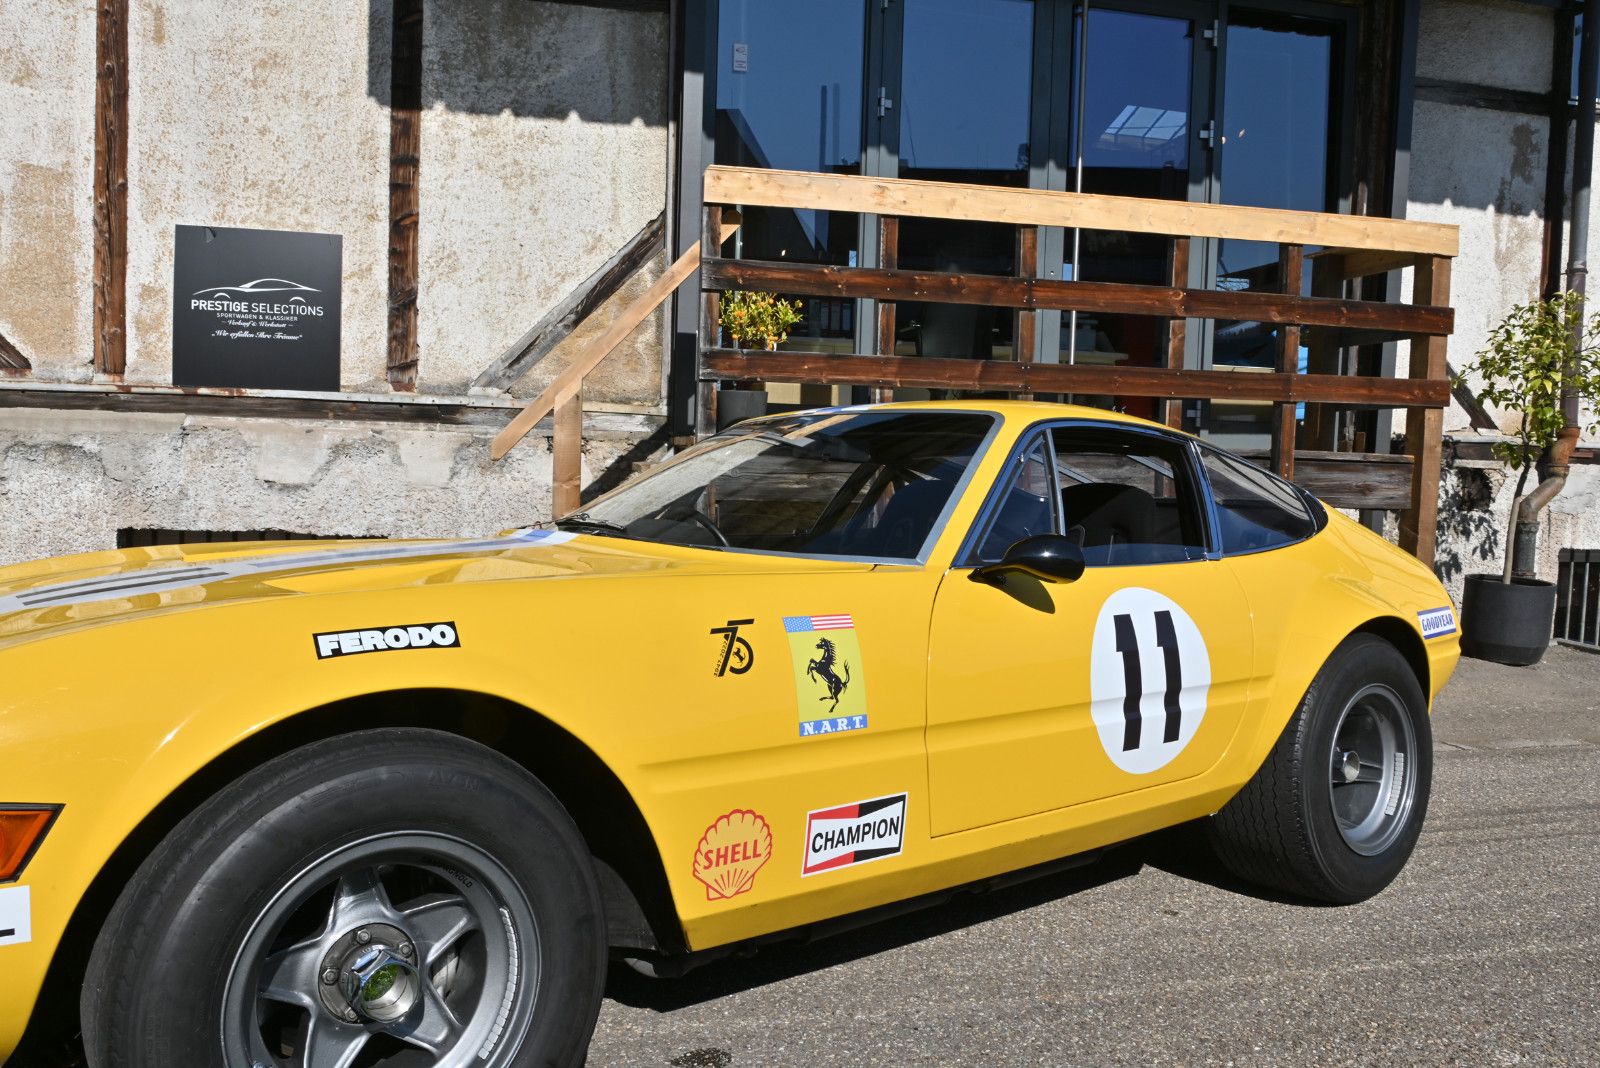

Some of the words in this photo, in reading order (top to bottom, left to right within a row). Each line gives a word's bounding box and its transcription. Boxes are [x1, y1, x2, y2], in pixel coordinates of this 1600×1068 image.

[191, 299, 249, 313] PRESTIGE
[251, 302, 324, 316] SELECTIONS
[216, 312, 257, 320] SPORTWAGEN
[255, 331, 272, 339] Ihre
[1421, 613, 1454, 631] GOODYEAR
[316, 624, 456, 657] FERODO
[710, 618, 754, 677] 75
[1113, 610, 1182, 752] 11
[803, 715, 864, 736] N.A.R.T.
[812, 816, 900, 853] CHAMPION
[703, 839, 762, 870] SHELL
